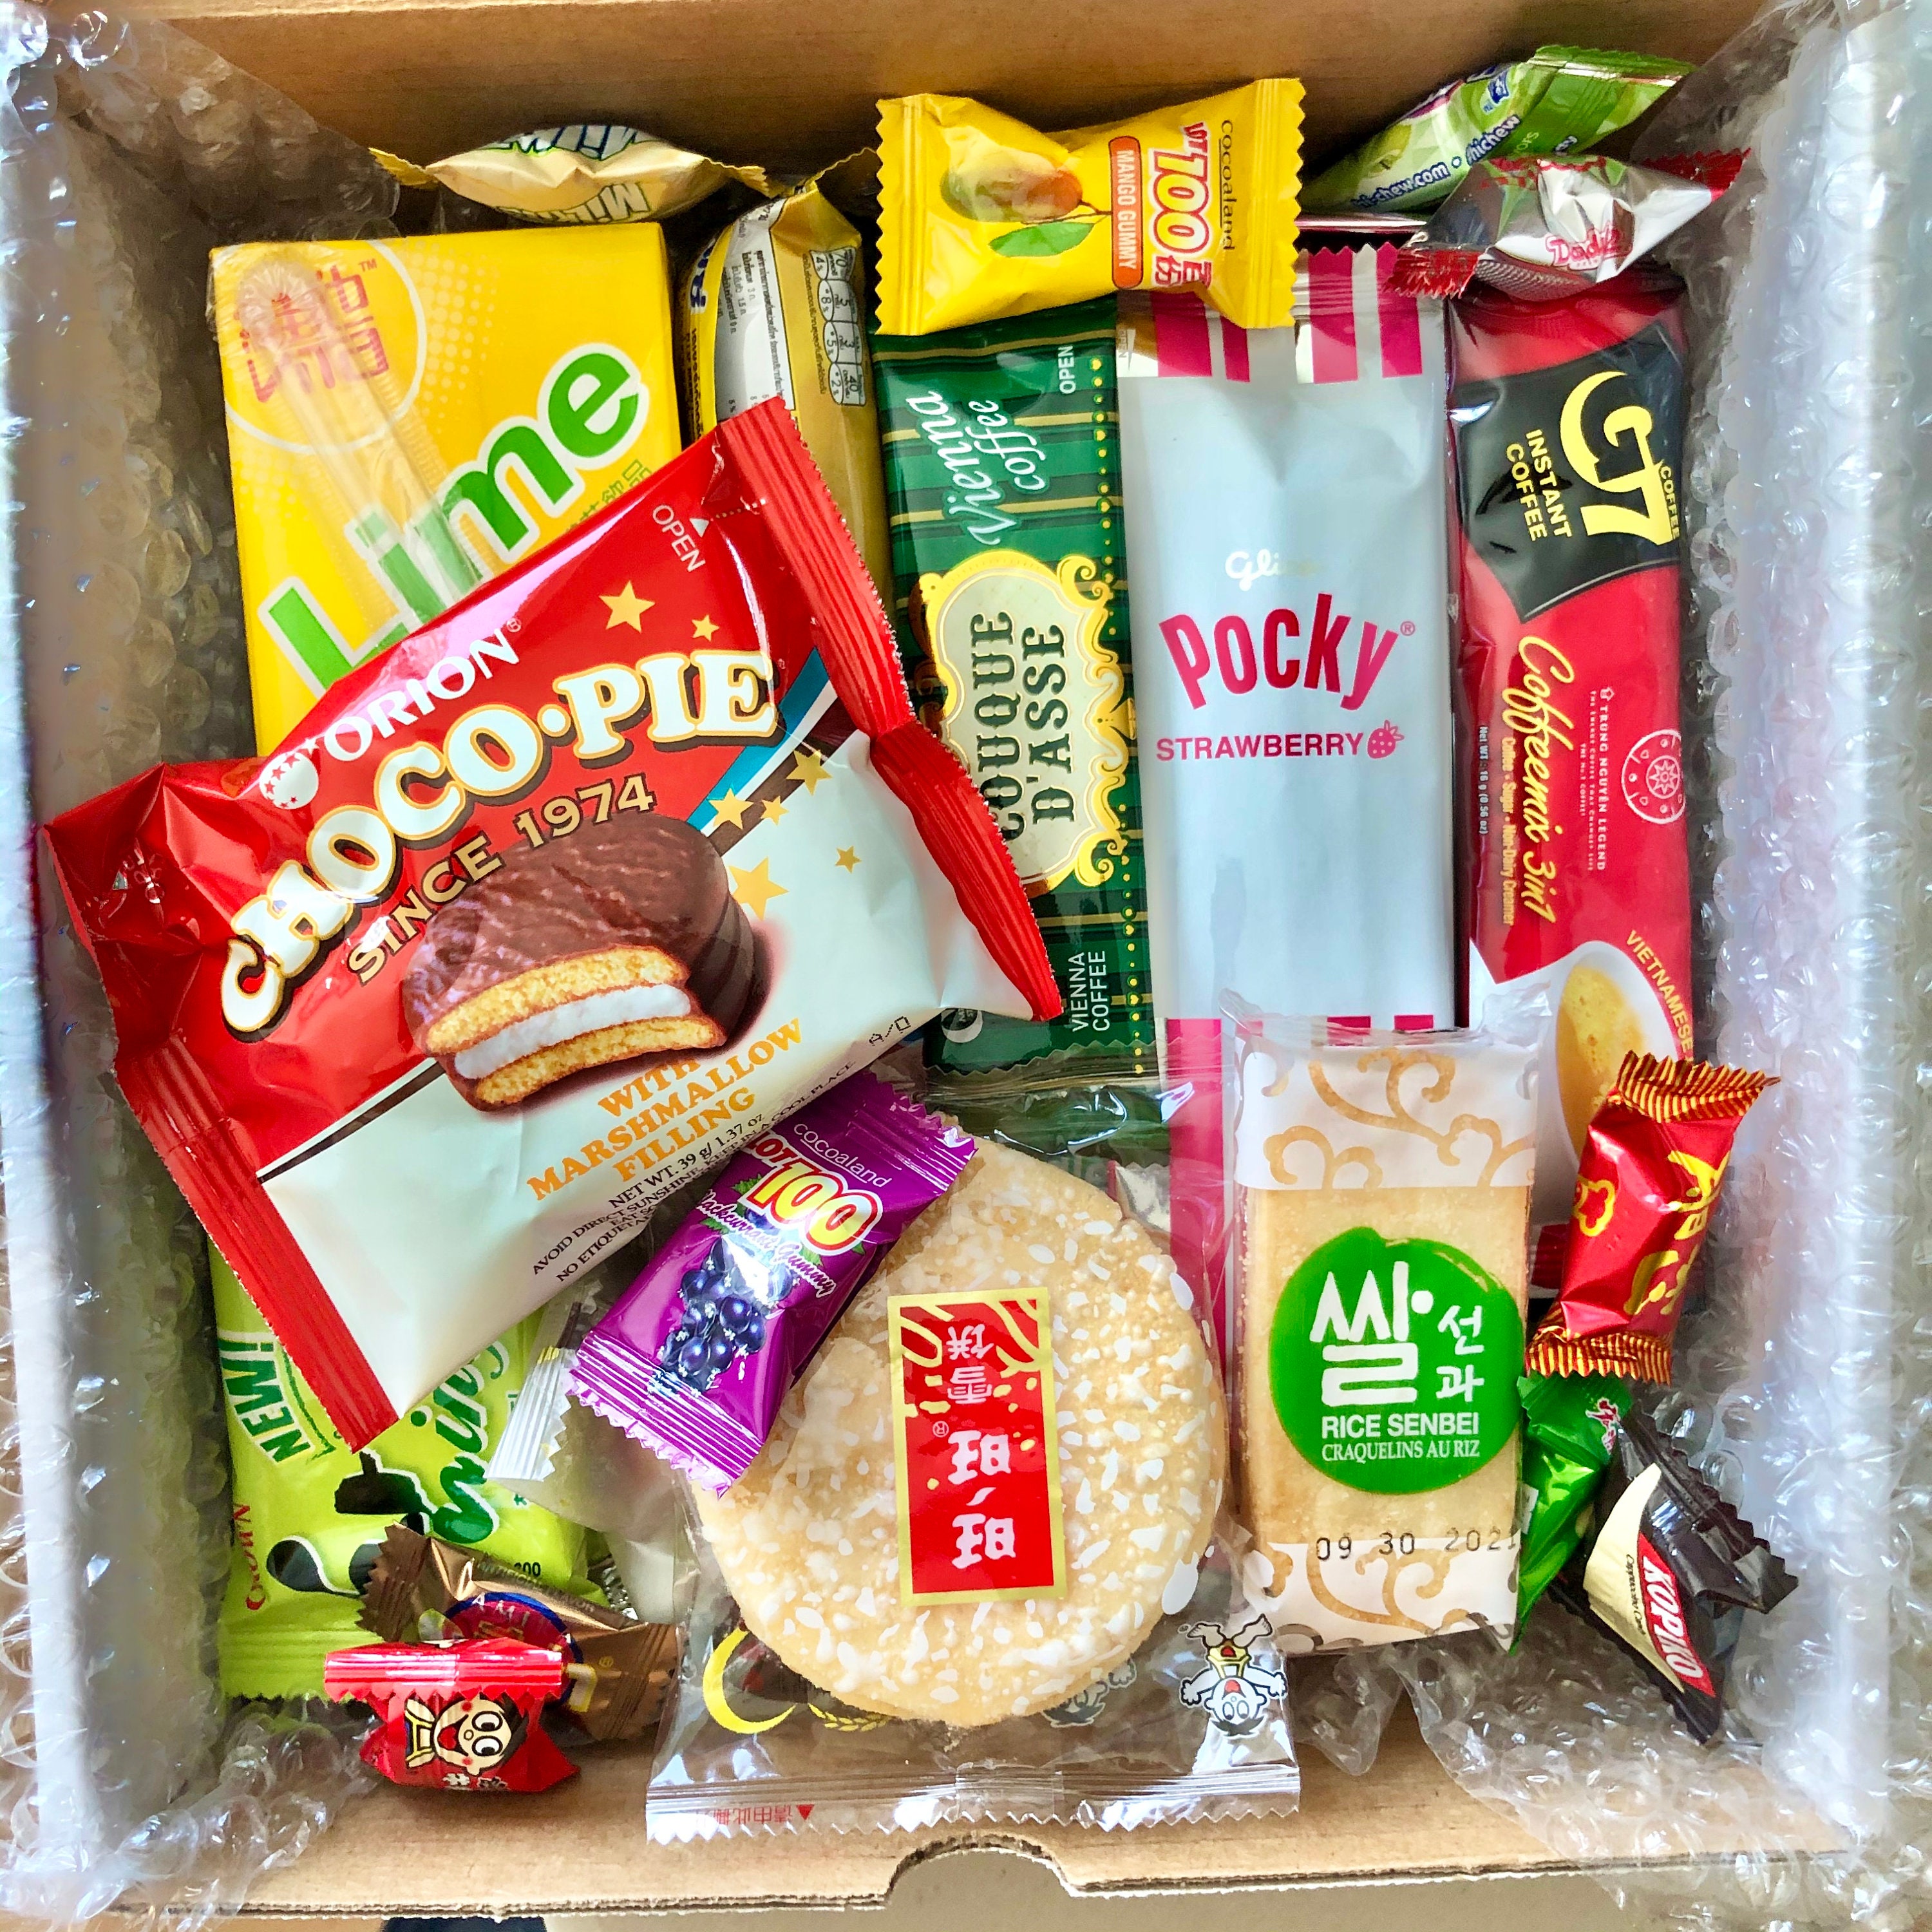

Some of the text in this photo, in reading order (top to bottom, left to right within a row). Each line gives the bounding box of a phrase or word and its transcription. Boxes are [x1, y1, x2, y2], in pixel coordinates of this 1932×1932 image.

[1116, 149, 1137, 270] MANGO GUMMY
[1153, 150, 1209, 254] 100
[1221, 119, 1237, 251] cocoaland
[1058, 345, 1077, 395] OPEN
[905, 390, 1018, 546] Vienna
[965, 399, 1046, 491] coffee
[1525, 428, 1573, 538] INSTANT
[1560, 370, 1675, 546] G7
[268, 352, 639, 690] Lime
[652, 504, 706, 573] OPEN
[1505, 442, 1547, 542] COFFEE
[1659, 464, 1680, 540] COFFEE
[324, 627, 520, 761] ORION
[970, 611, 1027, 840] COUQUE
[1020, 624, 1075, 825] D'ASSE
[1598, 705, 1608, 752] TRUNG
[1156, 732, 1363, 762] STRAWBERRY
[1502, 737, 1516, 770] Coffee
[1502, 635, 1575, 923] Coffeemix 3in1
[1499, 781, 1516, 814] Sugar
[347, 773, 657, 988] SINCE 1974
[1596, 818, 1607, 871] LEGEND
[1501, 880, 1517, 926] Creamer
[1068, 951, 1088, 1032] VIENNA
[1088, 950, 1110, 1032] COFFEE
[1624, 929, 1694, 1058] VIETNAMESE
[526, 1018, 804, 1200] MARSHMALLOW
[597, 1058, 701, 1119] WITH
[613, 1087, 756, 1182] FILLING
[532, 1236, 573, 1276] AVOID
[572, 1209, 626, 1238] DIRECT
[772, 1096, 810, 1122] COOL
[608, 1182, 647, 1209] NET
[643, 1164, 679, 1188] WT.
[677, 1153, 697, 1171] 39
[714, 1122, 744, 1148] 1.37
[747, 1113, 764, 1128] oz
[793, 1122, 893, 1189] cocoaland
[696, 1189, 837, 1298] lackcurrant Gummy
[744, 1159, 878, 1251] 100
[555, 1262, 579, 1282] NO
[946, 1323, 994, 1405] 雪饼
[1321, 1412, 1481, 1439] RICE SENBEI
[1321, 1439, 1481, 1464] CRAQUELINS AU RIZ
[1315, 1527, 1520, 1562] 09 30 2021
[1643, 1555, 1704, 1679] KOPIKO
